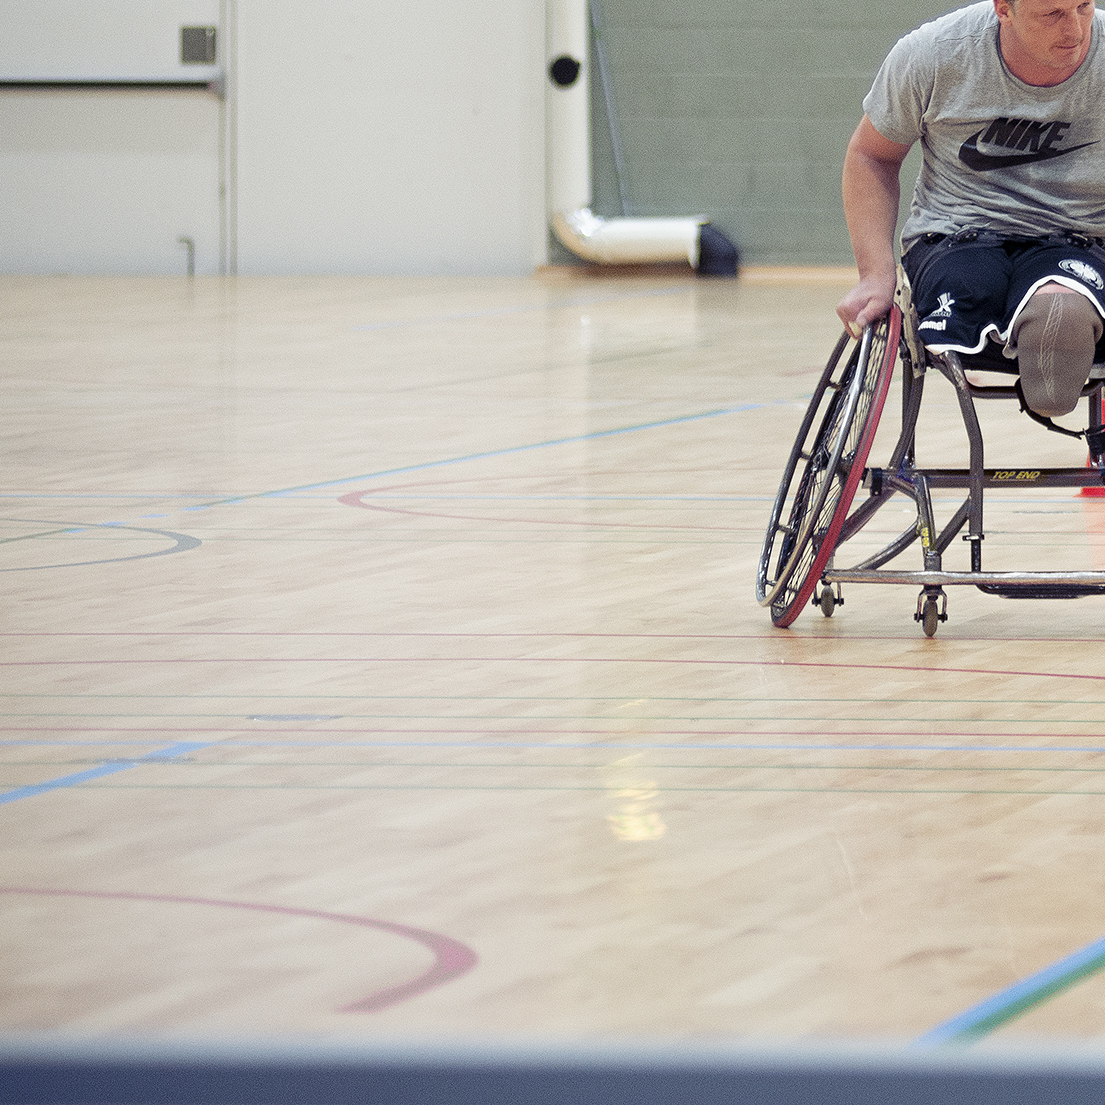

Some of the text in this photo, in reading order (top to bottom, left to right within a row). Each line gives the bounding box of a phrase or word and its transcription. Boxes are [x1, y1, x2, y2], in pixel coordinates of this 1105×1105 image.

[980, 116, 1072, 152] NIKE
[992, 471, 1041, 479] TOP END
